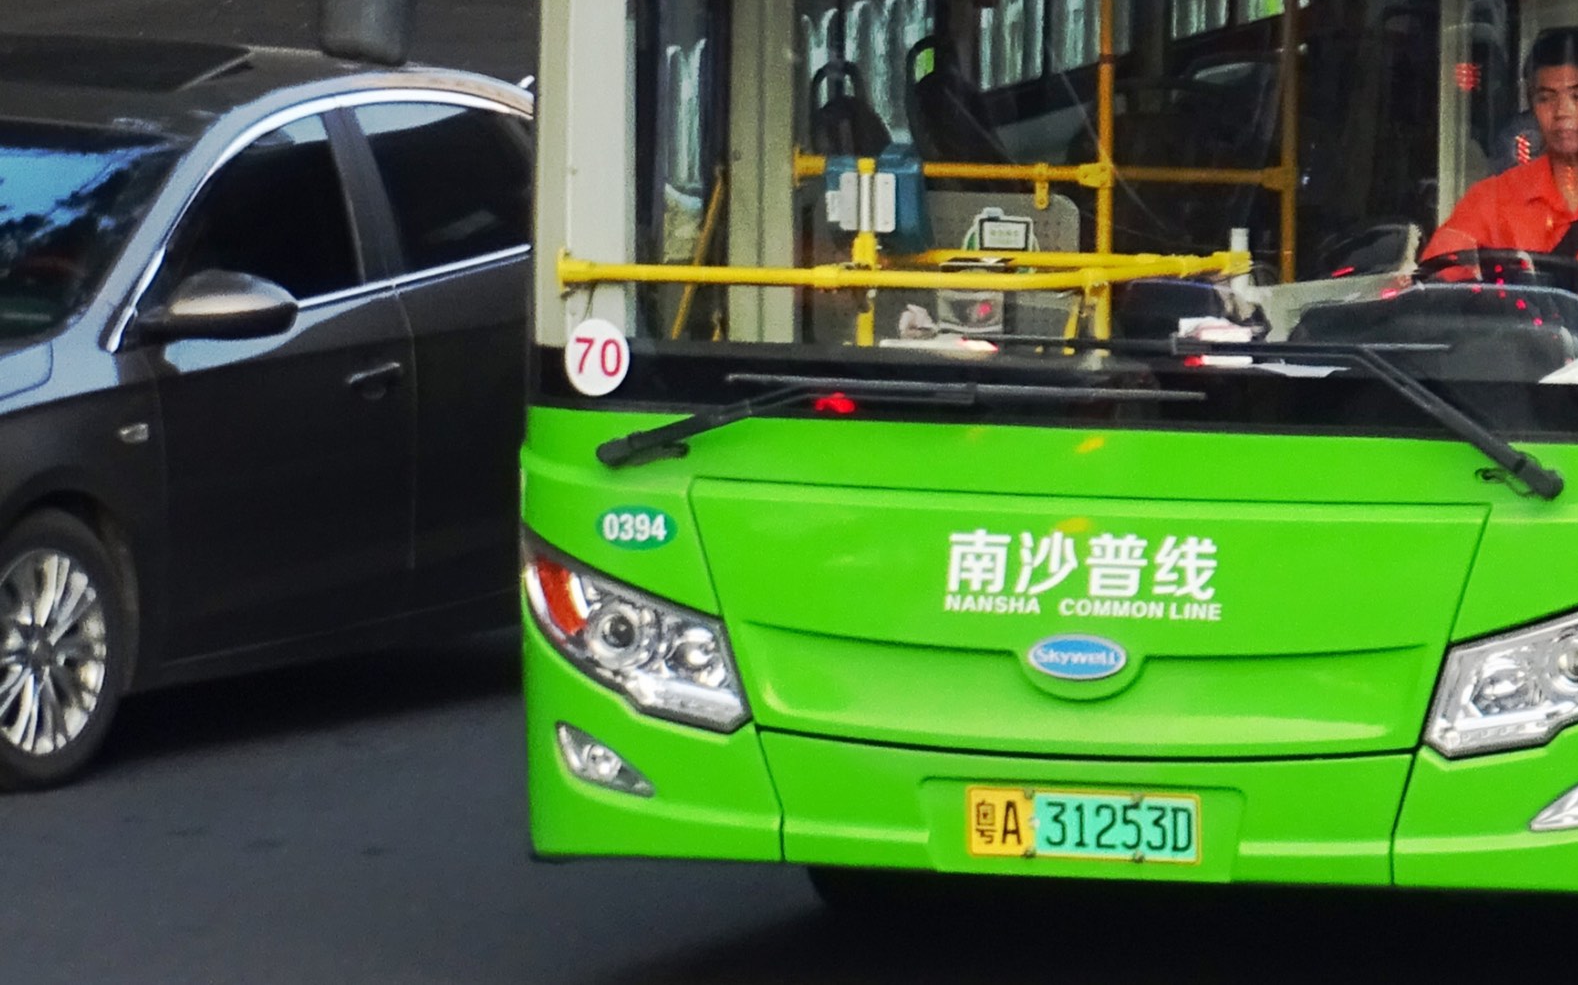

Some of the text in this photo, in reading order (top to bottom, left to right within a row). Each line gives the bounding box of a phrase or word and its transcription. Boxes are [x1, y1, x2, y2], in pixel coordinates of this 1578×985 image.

[575, 336, 623, 377] 70
[602, 513, 667, 542] 0394
[946, 528, 1218, 601] 南沙普线
[944, 594, 1223, 622] NANSHA COMMON LINE
[1045, 800, 1194, 853] 31253D
